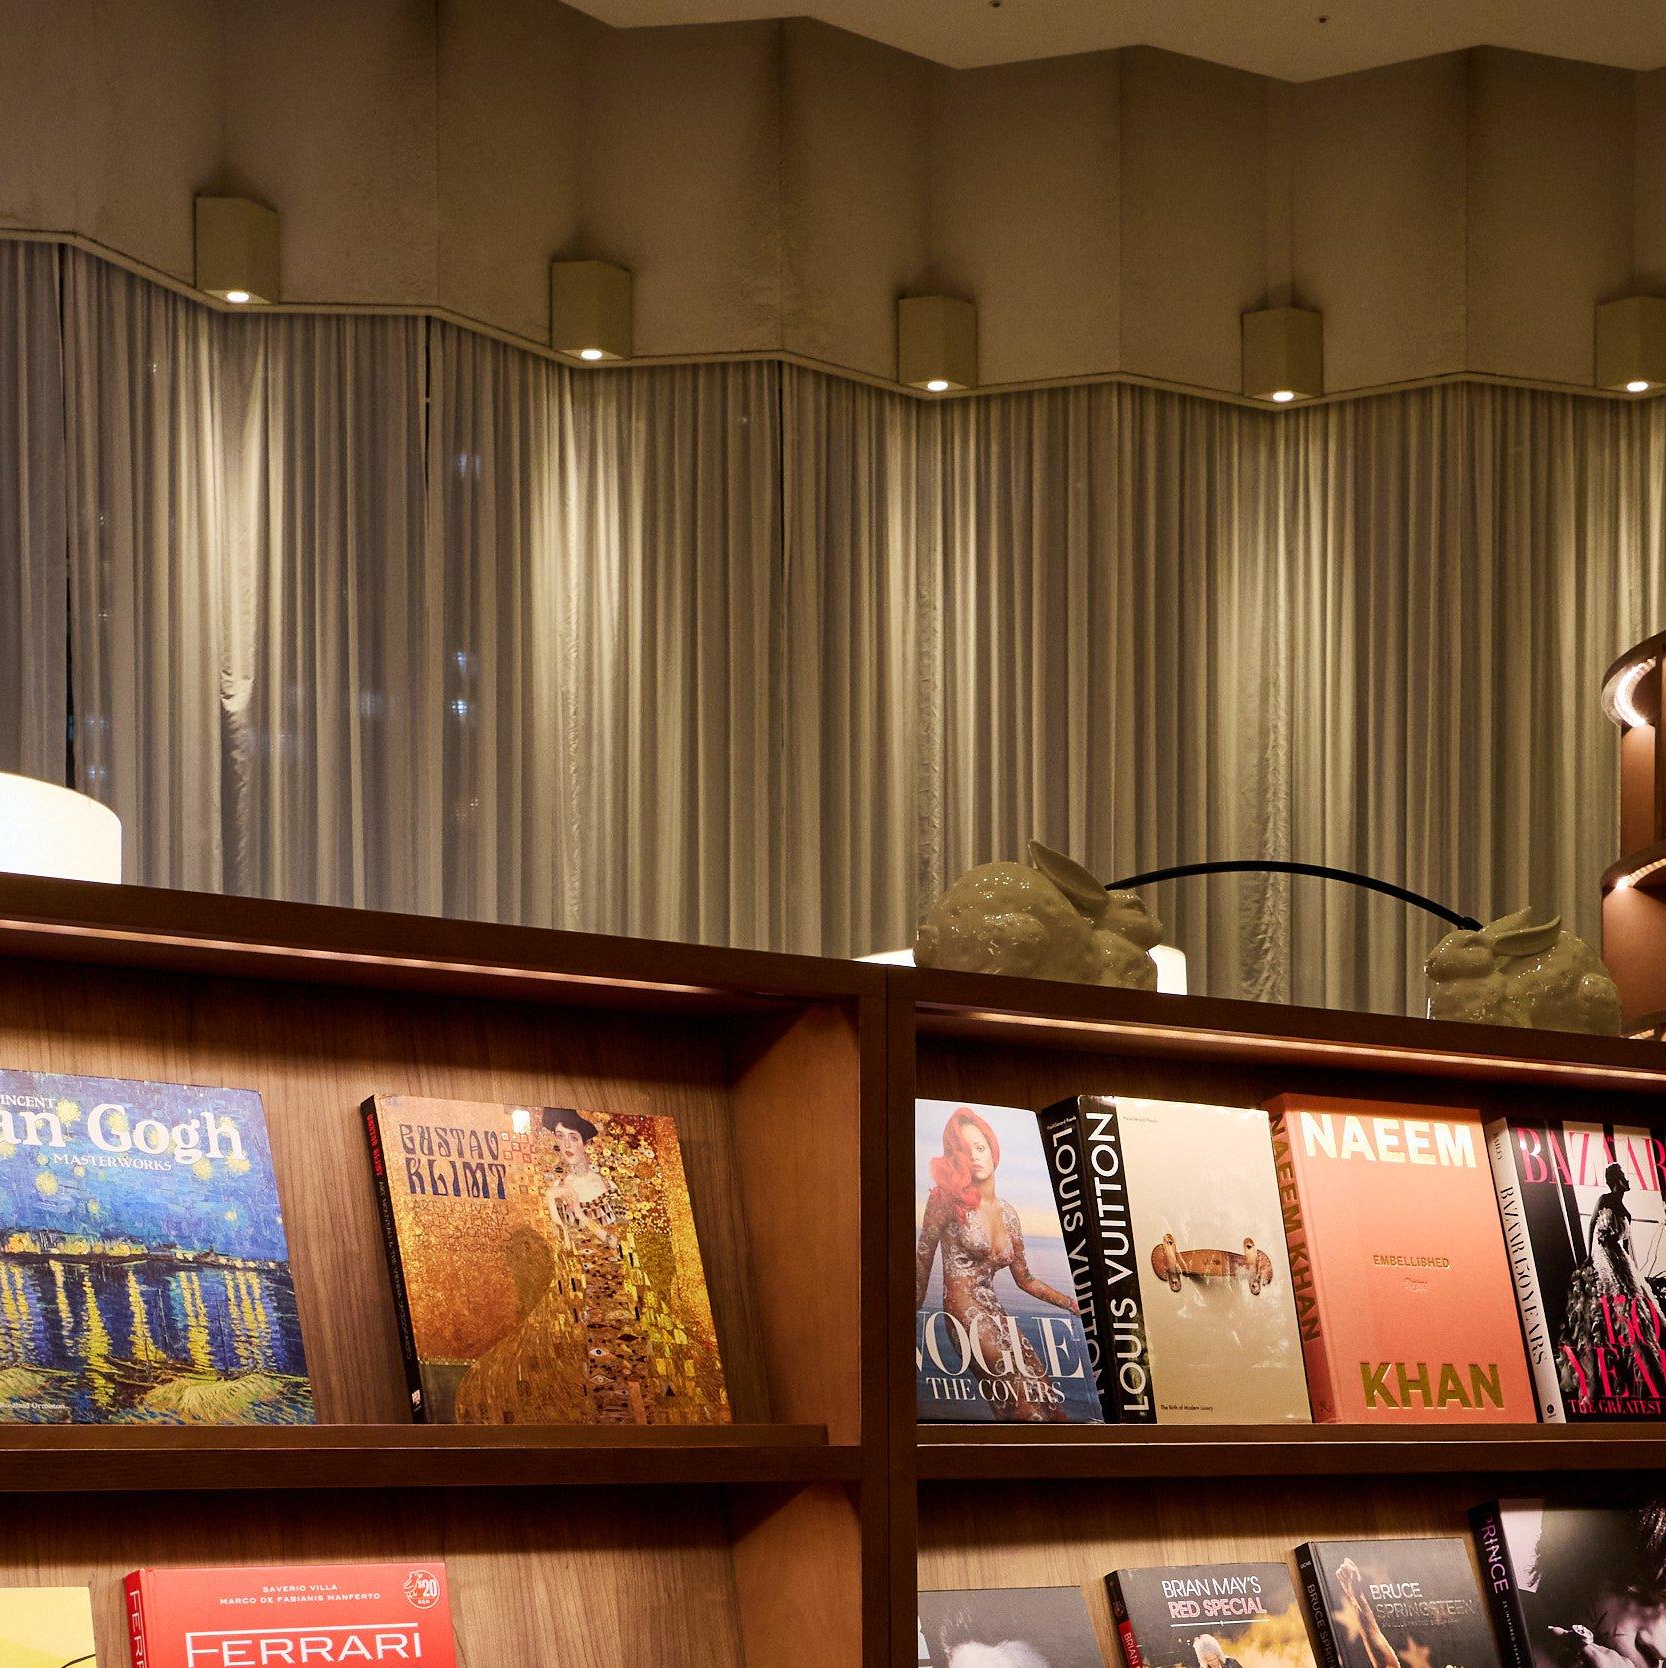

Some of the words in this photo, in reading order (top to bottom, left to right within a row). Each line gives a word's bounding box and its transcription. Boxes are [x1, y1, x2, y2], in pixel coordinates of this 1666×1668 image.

[87, 1103, 247, 1165] Gogh
[399, 1124, 499, 1161] GUSTAV
[1299, 1111, 1477, 1168] NAEEM
[54, 1153, 172, 1172] MASTERWORKS
[405, 1157, 507, 1199] KLIMT
[1053, 1127, 1083, 1232] LOUIS
[1086, 1113, 1133, 1285] VUITTON
[1373, 1253, 1451, 1271] EMBELLISHED
[1110, 1298, 1150, 1412] LOUIS
[926, 1377, 976, 1400] THE
[978, 1378, 1065, 1403] COVERS
[1359, 1361, 1505, 1410] KHAN
[1598, 1400, 1661, 1415] GREATEST
[220, 1597, 256, 1605] MARCO
[260, 1596, 273, 1604] DE
[277, 1594, 324, 1603] FABIANIS
[327, 1592, 381, 1601] MANFERTO
[262, 1584, 306, 1593] SAVERIO
[1162, 1578, 1210, 1598] BRIAN
[1213, 1576, 1262, 1595] MAY'S
[1307, 1583, 1325, 1628] BRUCE
[1369, 1582, 1423, 1600] BRUCE
[1168, 1601, 1201, 1619] RED
[1203, 1597, 1268, 1617] SPECIAL
[185, 1622, 423, 1668] FERRARI
